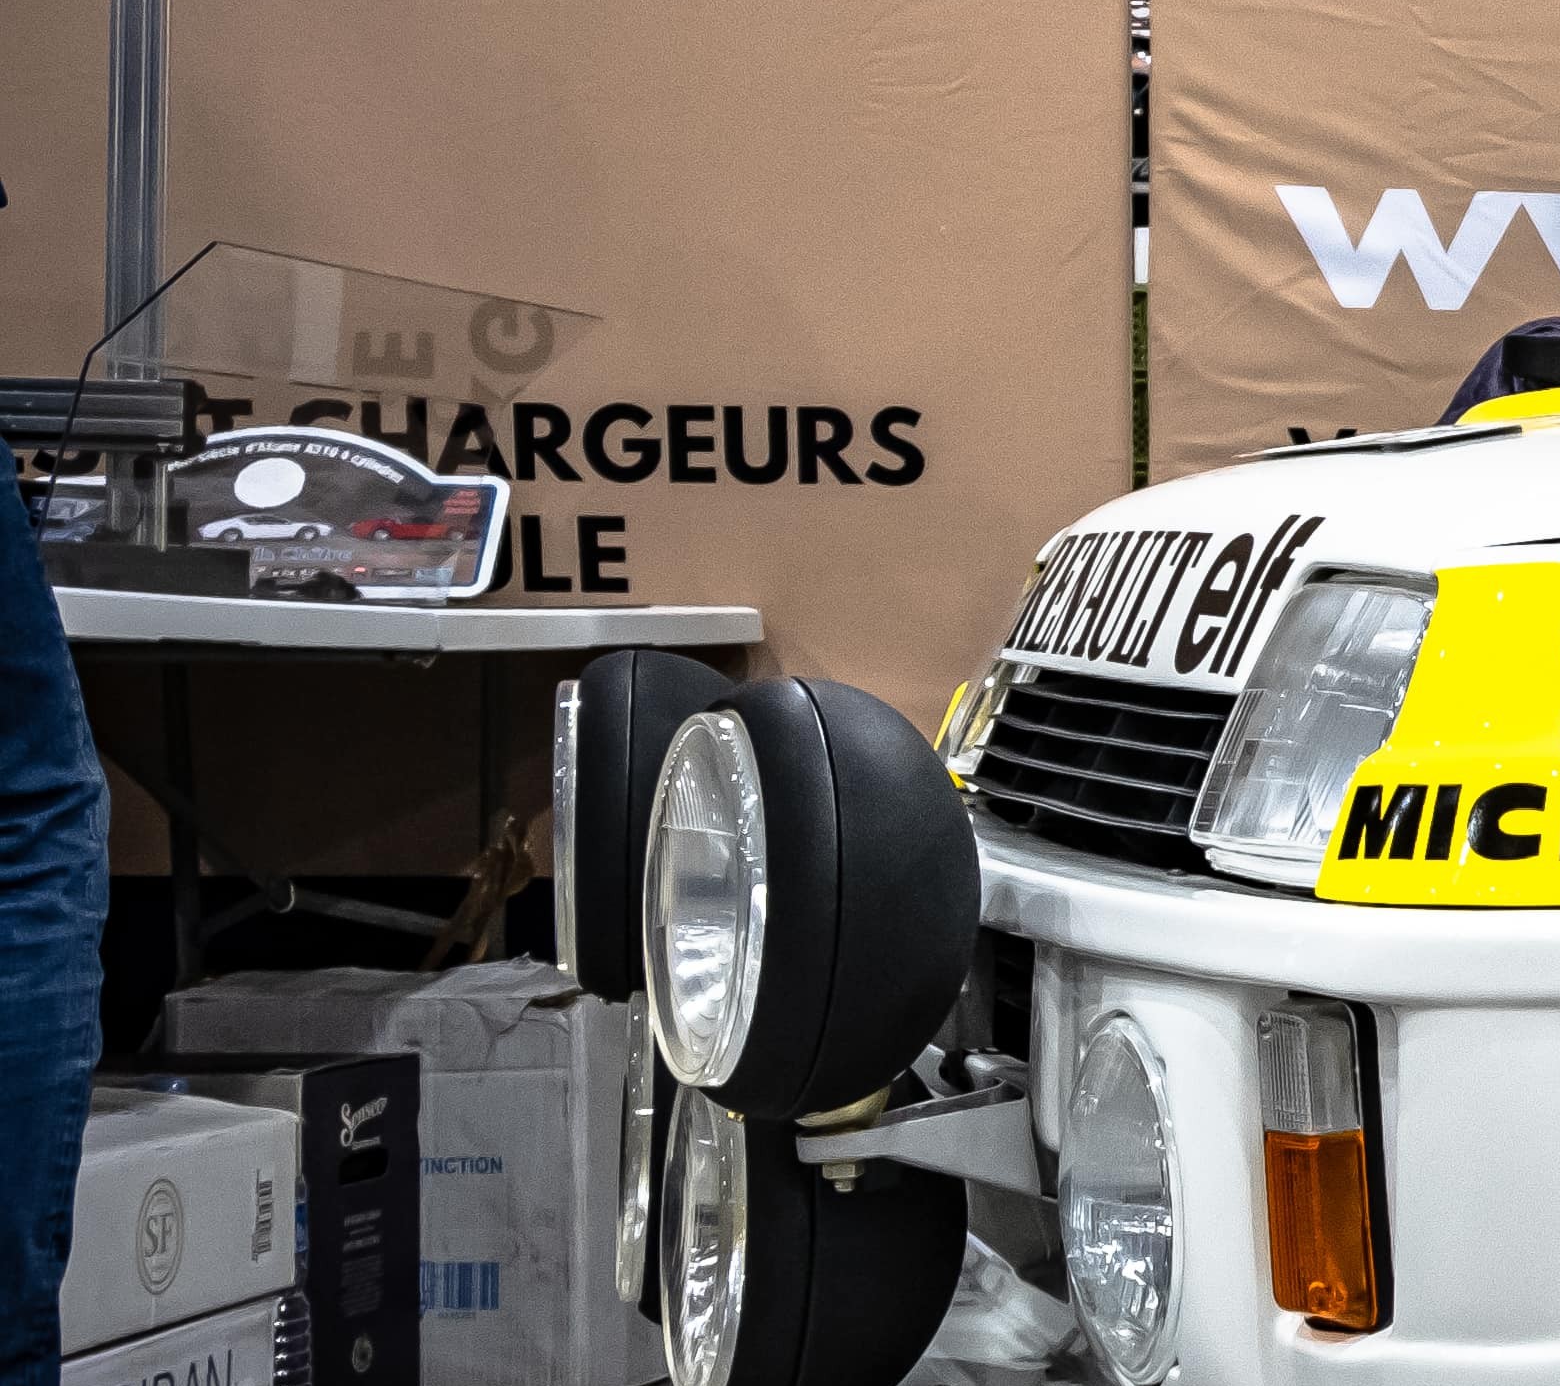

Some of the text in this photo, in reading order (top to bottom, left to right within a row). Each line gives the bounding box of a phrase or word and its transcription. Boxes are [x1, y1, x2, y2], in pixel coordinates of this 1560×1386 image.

[290, 398, 926, 485] HARGEURS
[1006, 513, 1327, 679] RENAULT elf
